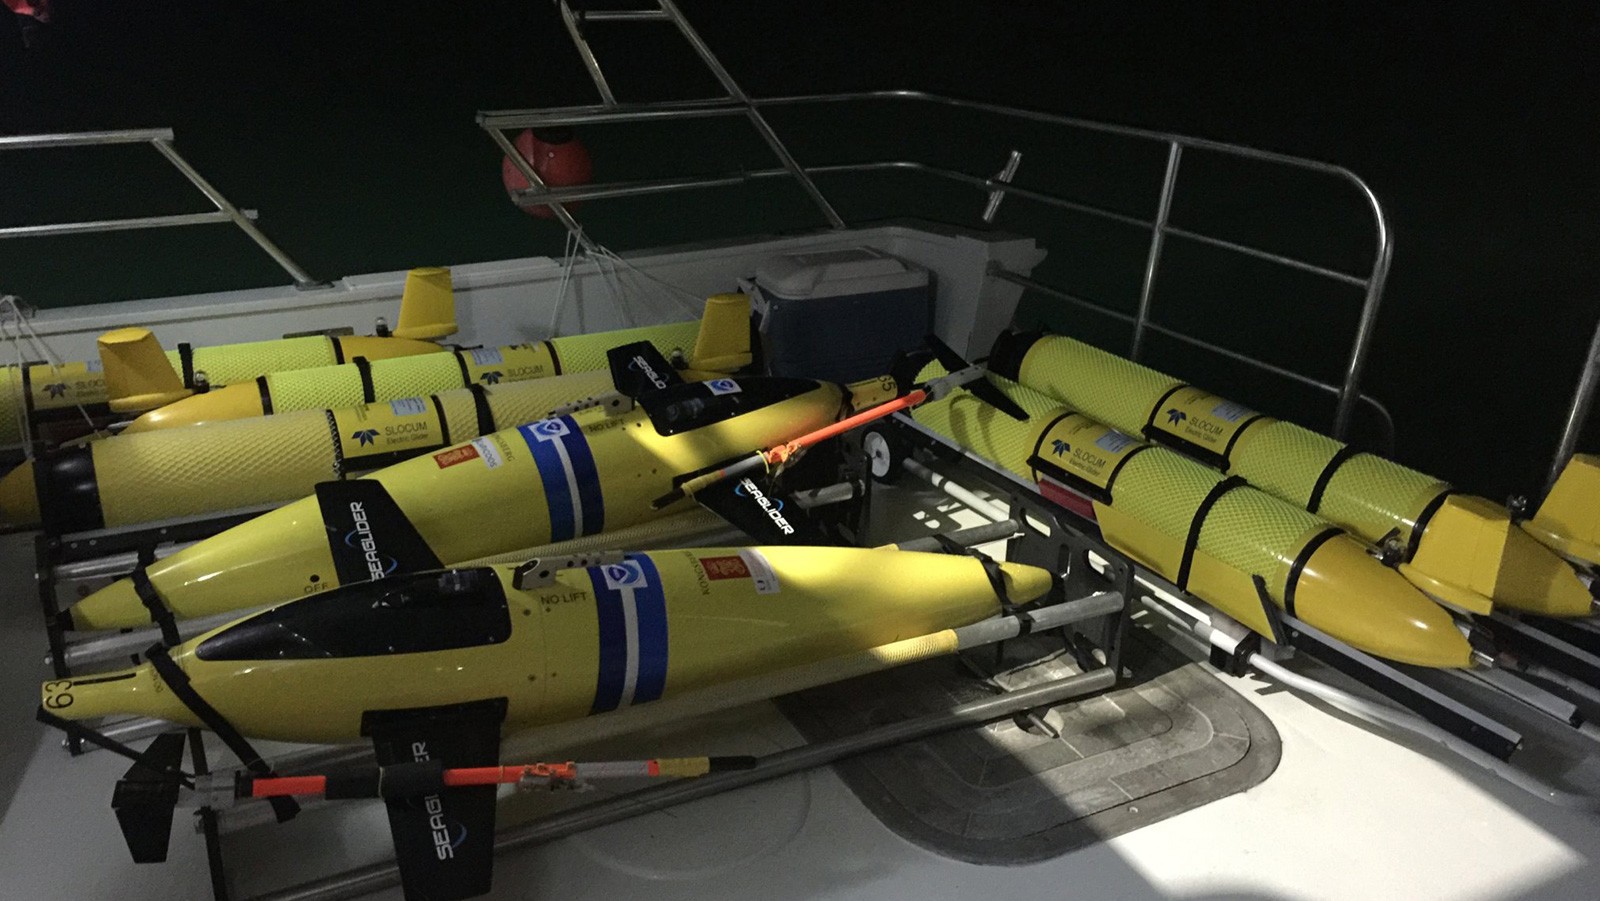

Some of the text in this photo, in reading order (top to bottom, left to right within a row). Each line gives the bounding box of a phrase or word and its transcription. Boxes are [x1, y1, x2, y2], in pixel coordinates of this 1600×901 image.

[633, 355, 667, 390] SEAGLID
[385, 422, 428, 436] SLOCUM
[1188, 416, 1225, 436] SLOCUM
[1073, 447, 1107, 468] SLOCUM
[740, 477, 795, 535] SEAGLIDER
[350, 500, 385, 583] SEAGLIDER
[304, 582, 329, 594] OFF
[541, 591, 588, 605] NO LIFT
[45, 680, 74, 709] 63
